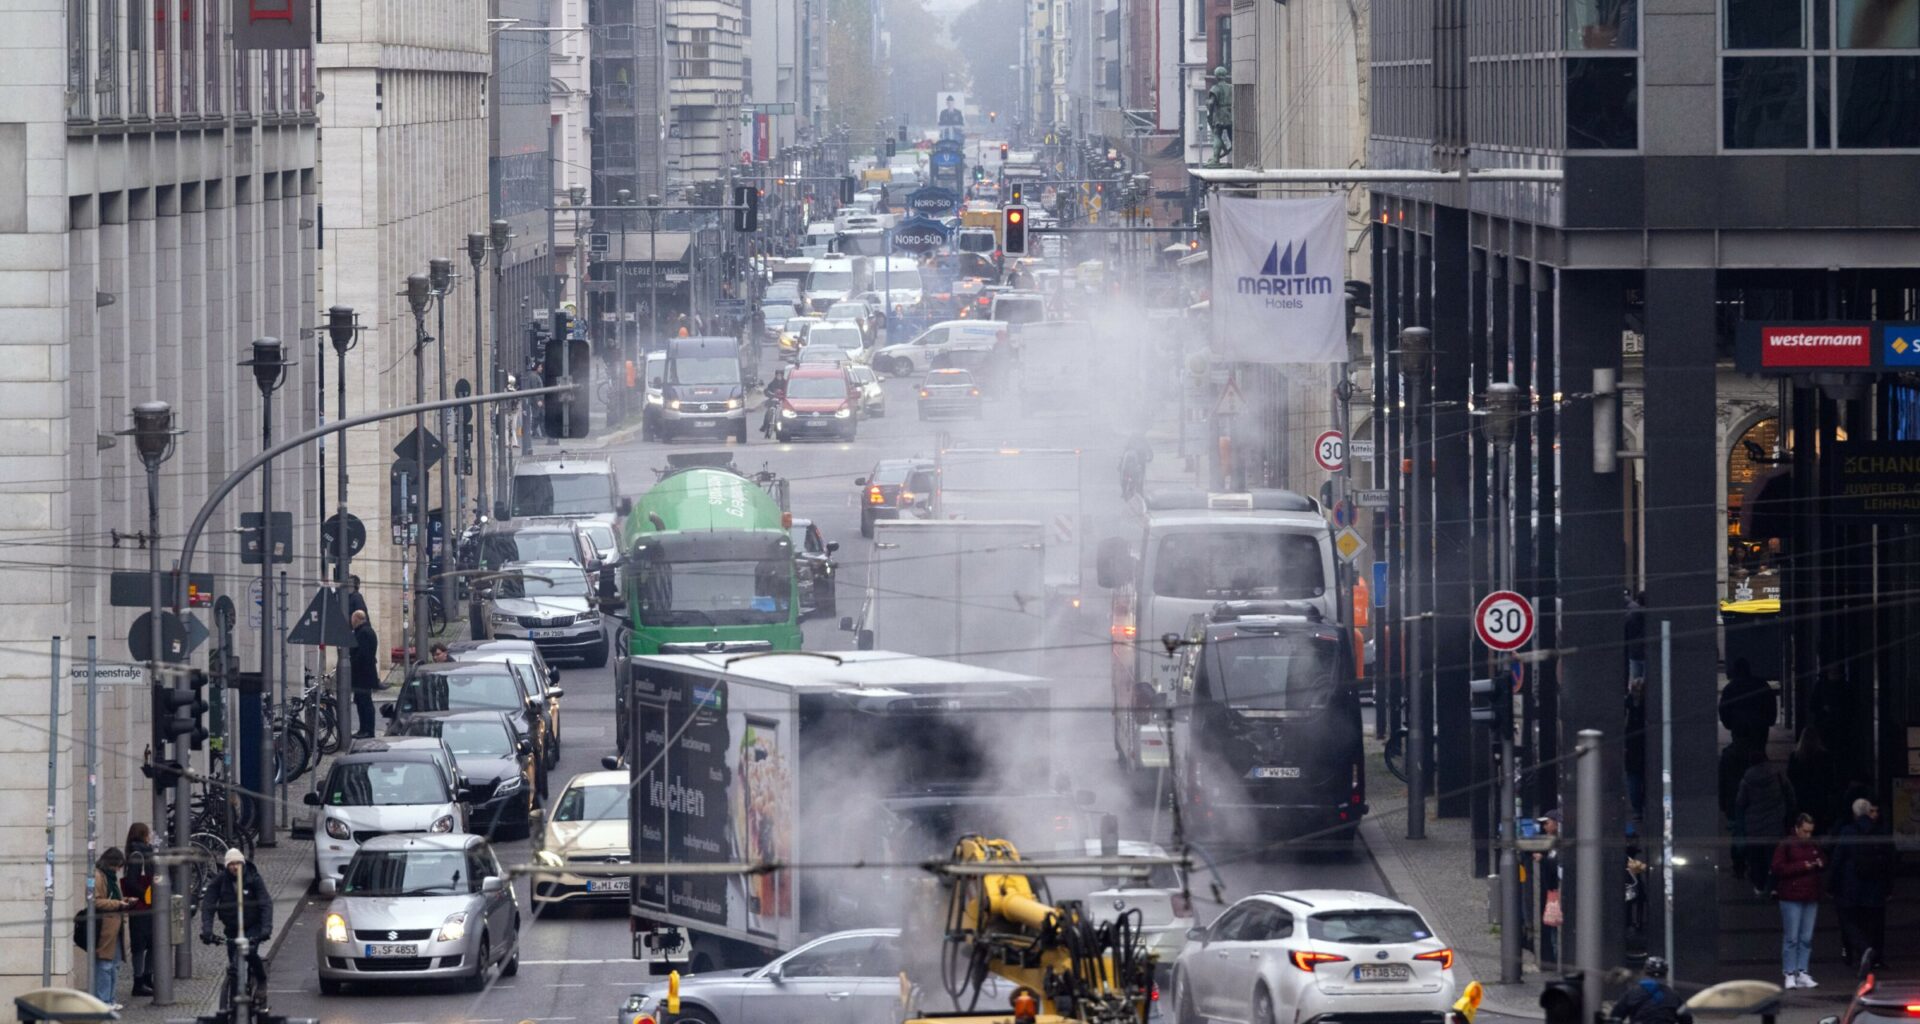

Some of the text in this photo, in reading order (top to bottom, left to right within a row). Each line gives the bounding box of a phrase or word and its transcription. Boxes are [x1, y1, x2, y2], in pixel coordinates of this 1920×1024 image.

[914, 199, 951, 207] NORD-SÜD
[895, 233, 943, 244] NORD-SÜD
[1237, 276, 1332, 295] MARITIM
[1265, 298, 1304, 309] Hotels
[1770, 333, 1862, 346] westermann
[1322, 442, 1343, 460] 30
[435, 521, 442, 532] P
[1489, 608, 1521, 634] 30
[72, 665, 141, 680] oroeenstraße
[613, 880, 630, 890] 478
[382, 945, 393, 955] SF
